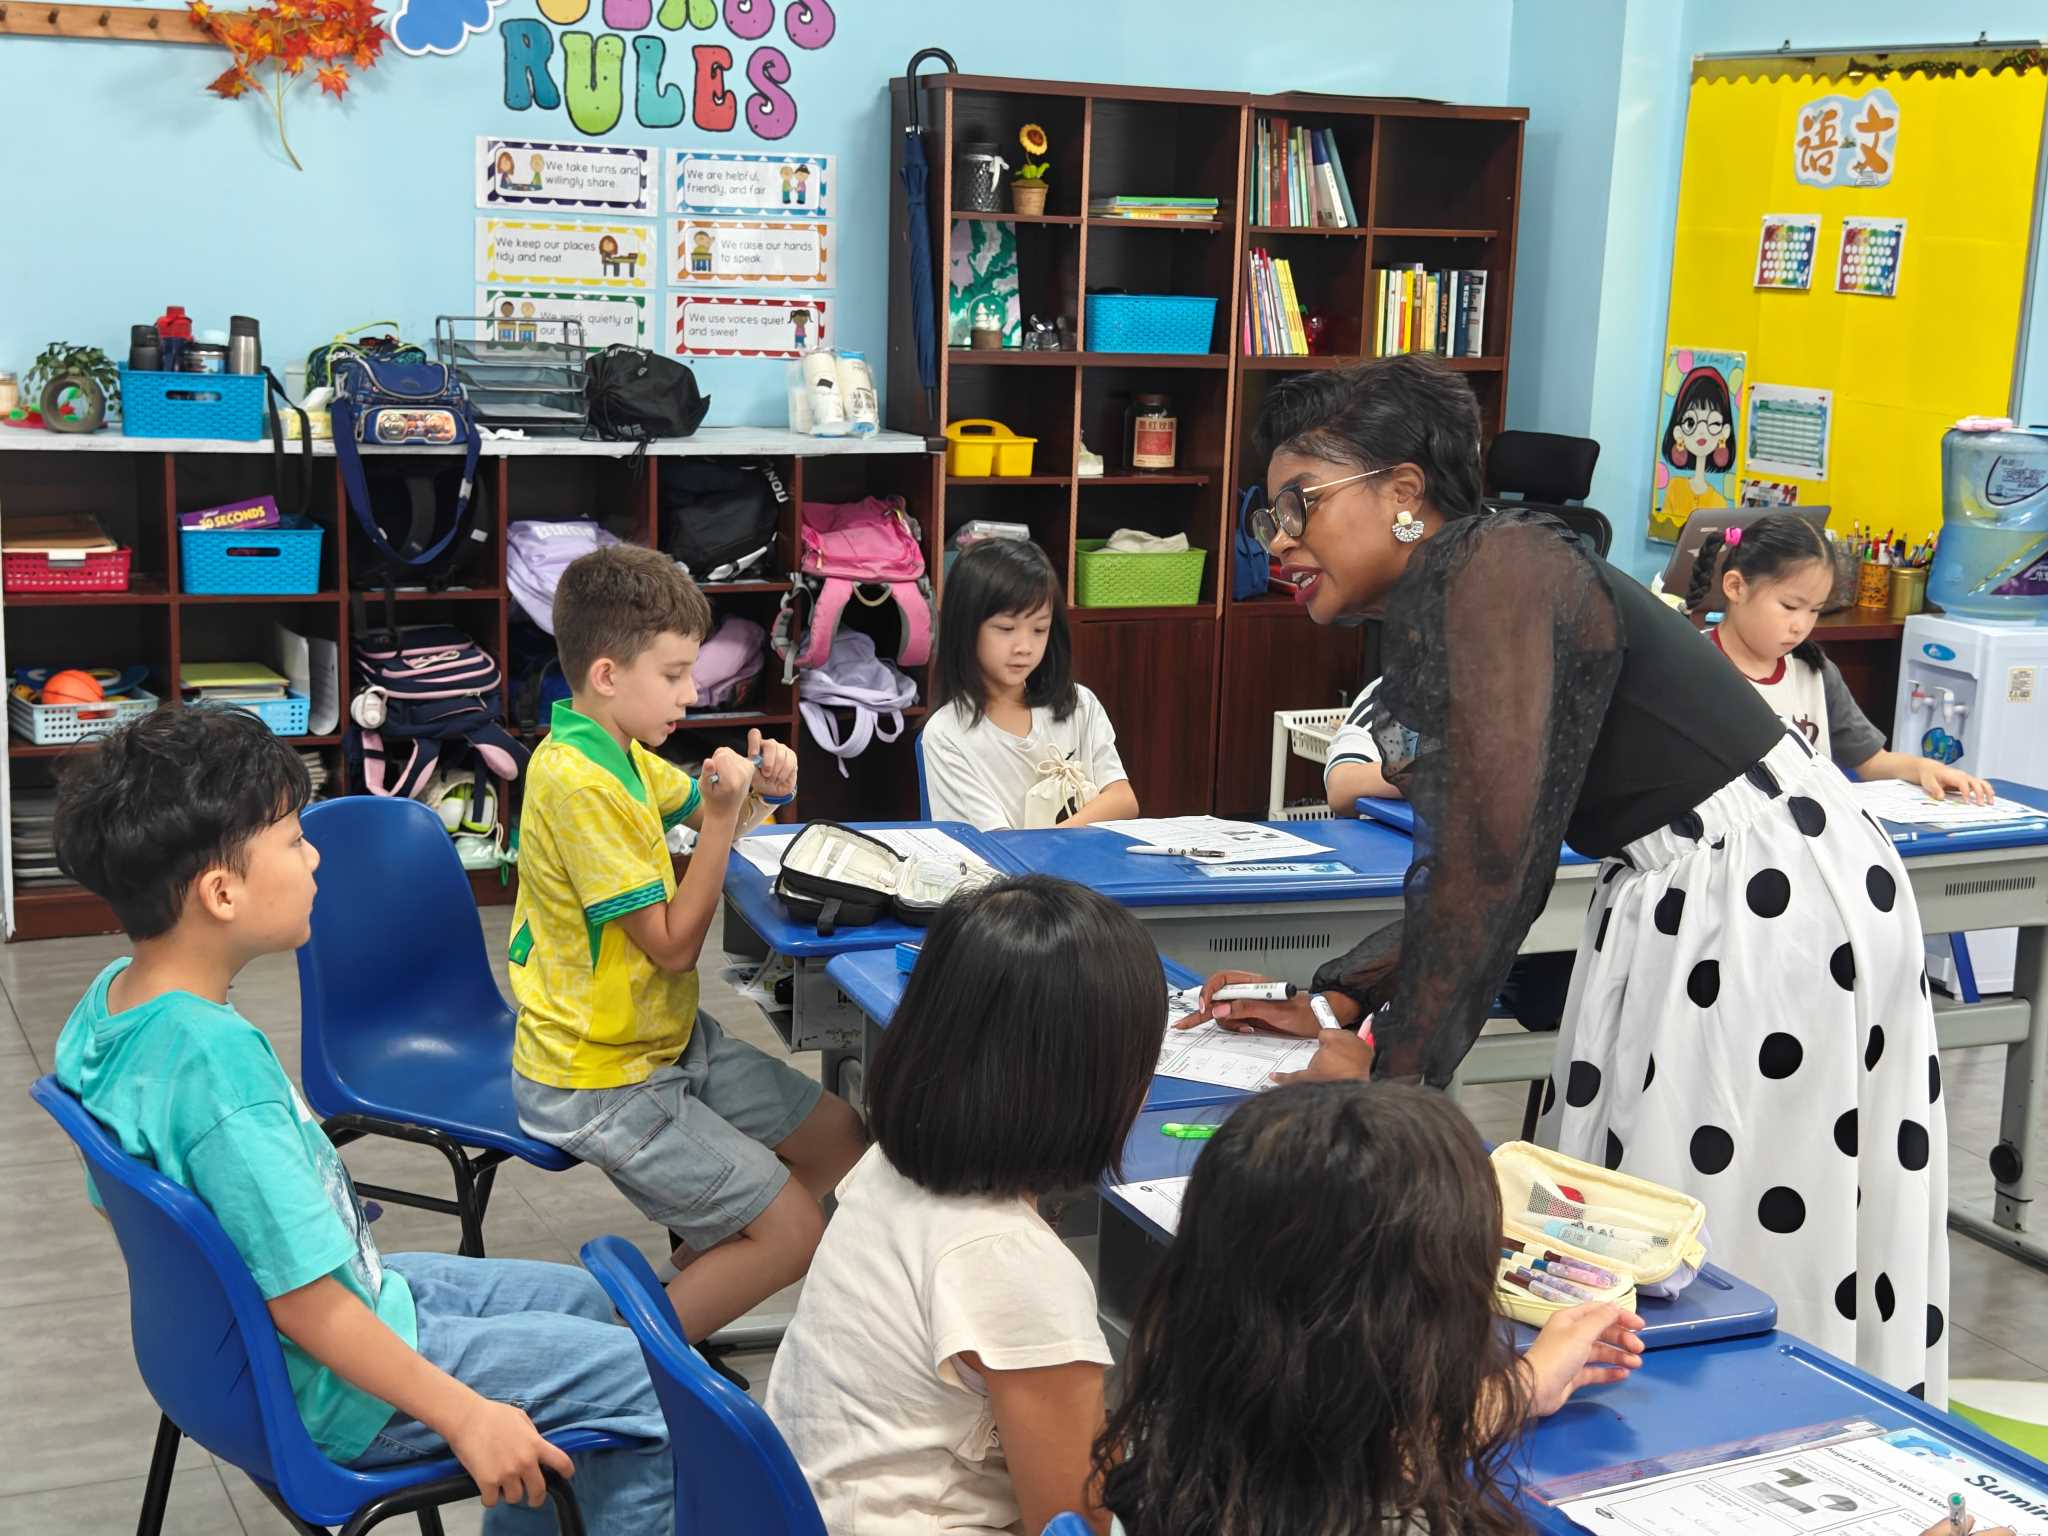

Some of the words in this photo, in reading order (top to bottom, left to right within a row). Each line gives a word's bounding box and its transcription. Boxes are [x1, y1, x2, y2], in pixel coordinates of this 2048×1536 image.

[500, 19, 797, 140] RULES
[545, 161, 562, 172] We
[566, 162, 588, 173] take
[591, 163, 617, 175] turns
[619, 165, 639, 176] and
[686, 169, 704, 181] We
[706, 172, 723, 181] are
[545, 174, 585, 189] willingly
[587, 176, 616, 189] share
[729, 183, 748, 195] and
[496, 238, 513, 248] We
[516, 238, 541, 251] keep
[544, 241, 561, 249] our
[563, 240, 596, 252] places
[721, 240, 737, 249] We
[739, 241, 764, 250] raise
[765, 242, 781, 251] our
[783, 240, 813, 252] hands
[496, 252, 515, 264] tidy
[517, 253, 537, 262] and
[539, 254, 562, 264] neat
[720, 253, 731, 263] to
[588, 313, 621, 327] quietly
[624, 315, 634, 325] at
[689, 313, 707, 322] We
[708, 315, 726, 323] use
[727, 315, 758, 325] voices
[760, 316, 785, 327] quiet
[540, 327, 556, 336] our
[688, 327, 708, 337] and
[710, 328, 739, 337] sweet
[214, 505, 266, 528] SECONDS
[1226, 864, 1300, 873] Jasmine
